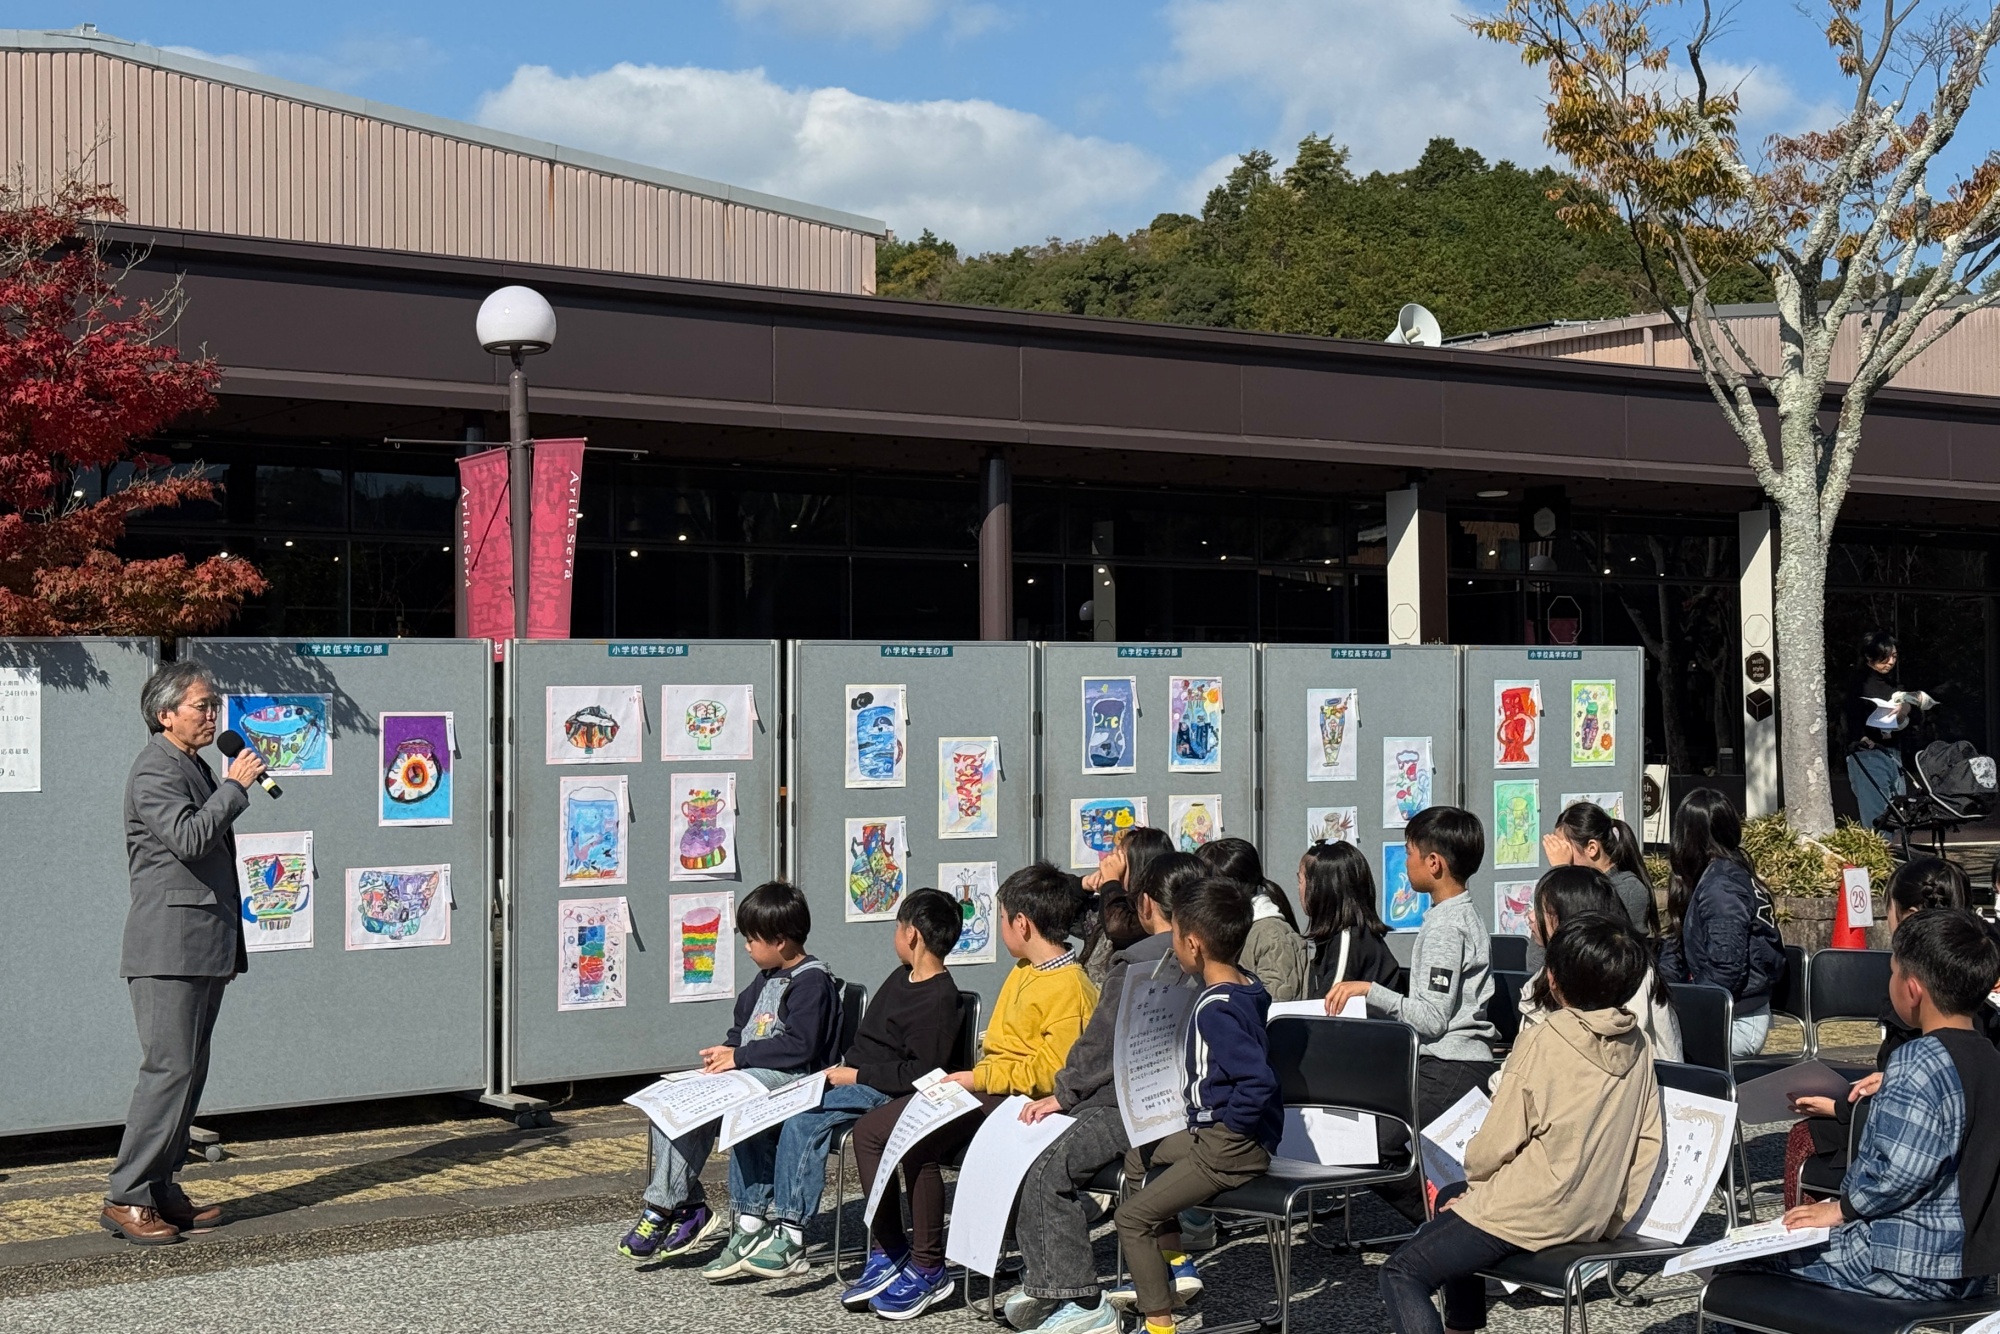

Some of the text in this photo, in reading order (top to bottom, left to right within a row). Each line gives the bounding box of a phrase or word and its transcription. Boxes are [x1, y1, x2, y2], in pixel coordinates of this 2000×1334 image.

[568, 470, 580, 529] Arita
[461, 486, 471, 539] Arita
[301, 644, 383, 655] 小学校低学年の部
[612, 645, 684, 655] 小学校低学年の部
[884, 646, 949, 656] 小学校中学年の部
[1120, 647, 1179, 657] 小学校中学年の部
[1333, 649, 1388, 658] 小学校高学年の部
[1530, 650, 1579, 659] 小学校高学年の部
[1751, 657, 1765, 665] with
[1852, 888, 1866, 910] 28
[1683, 1150, 1703, 1187] 賞状
